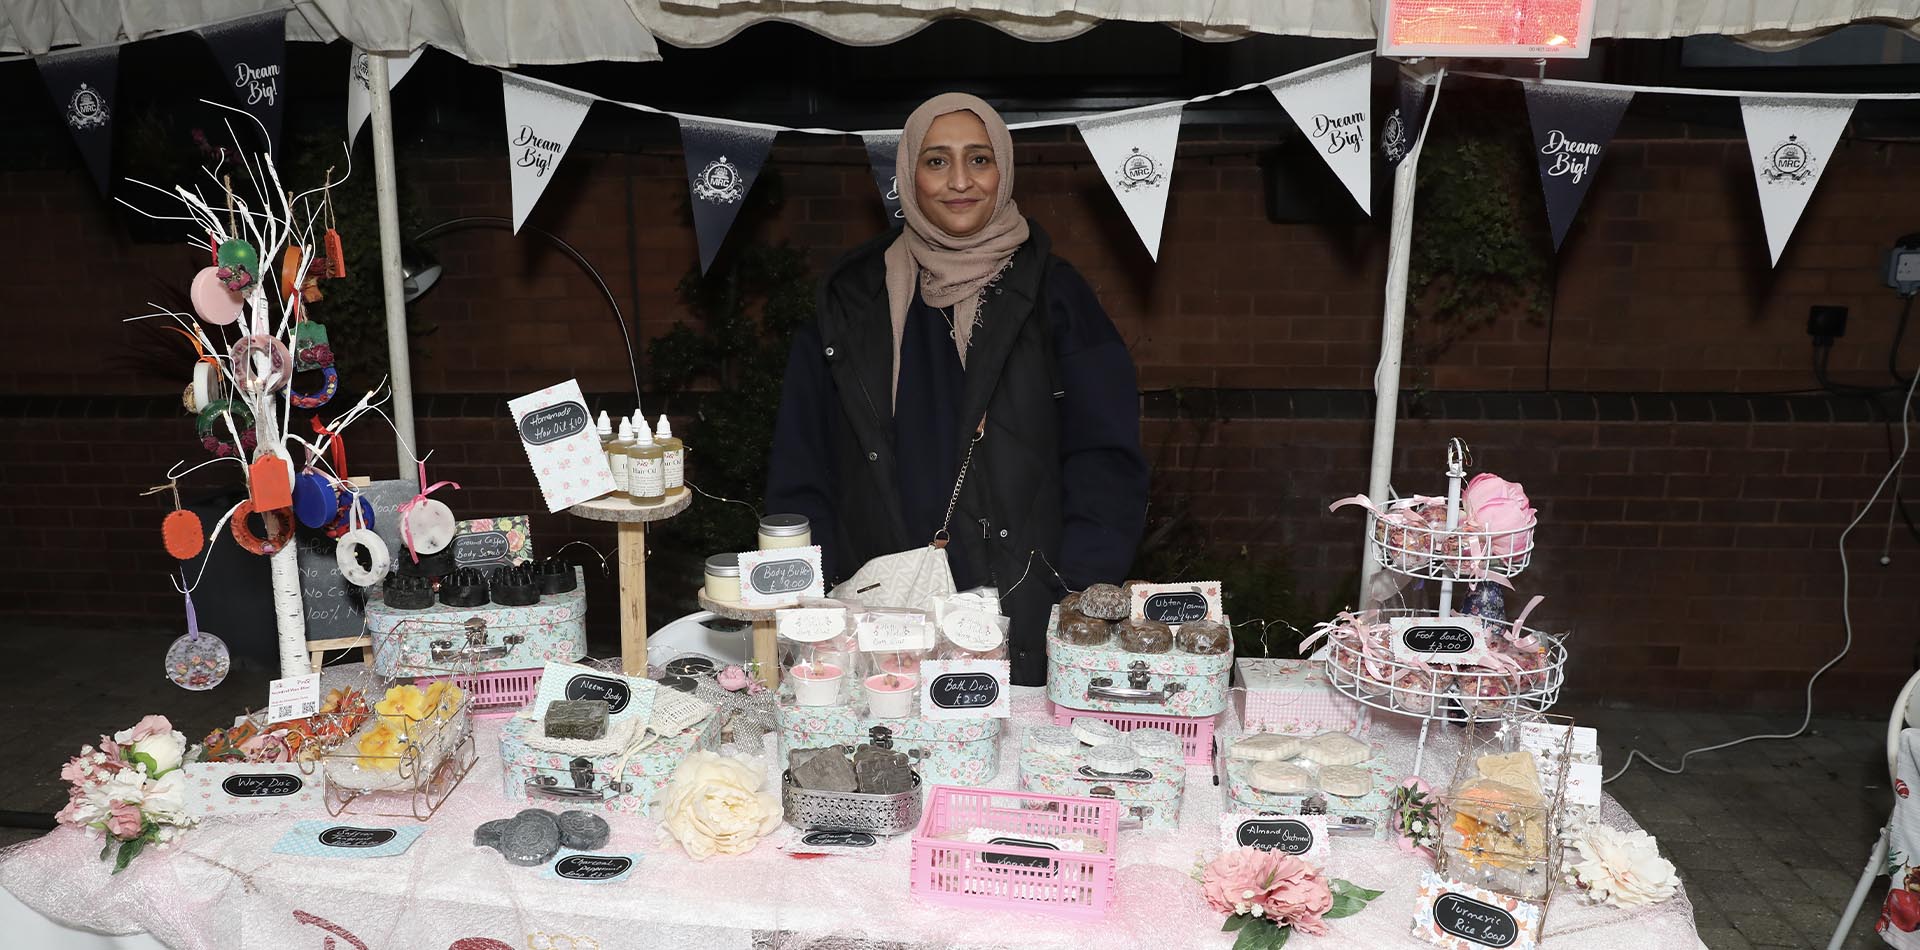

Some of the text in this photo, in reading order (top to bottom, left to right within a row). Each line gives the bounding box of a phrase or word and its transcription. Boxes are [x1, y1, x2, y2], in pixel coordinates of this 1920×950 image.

[234, 62, 280, 88] Dream
[248, 78, 278, 106] Big!
[80, 104, 96, 113] MRC
[1312, 112, 1365, 138] Dream
[513, 125, 563, 153] Dream
[1328, 125, 1364, 154] Big!
[1541, 130, 1601, 154] Dream
[517, 146, 553, 178] Big!
[1548, 152, 1590, 184] Big!
[1778, 160, 1800, 168] MRC
[1129, 168, 1150, 178] MRC
[710, 178, 730, 187] MRC
[530, 408, 572, 426] Homemade
[553, 421, 566, 434] Oil
[456, 539, 482, 547] Ground
[456, 549, 476, 559] Body
[764, 566, 785, 584] Body
[303, 588, 322, 598] No
[306, 604, 340, 624] 100%
[1415, 631, 1434, 639] Foot
[1429, 641, 1461, 650] £3.00
[580, 680, 604, 692] Neem
[603, 688, 622, 705] Body
[945, 678, 994, 691] Bath Dust
[238, 778, 264, 788] Wax
[1247, 825, 1281, 834] Almond
[1449, 896, 1501, 925] Turmeric
[1455, 918, 1506, 944] Rice Soap
